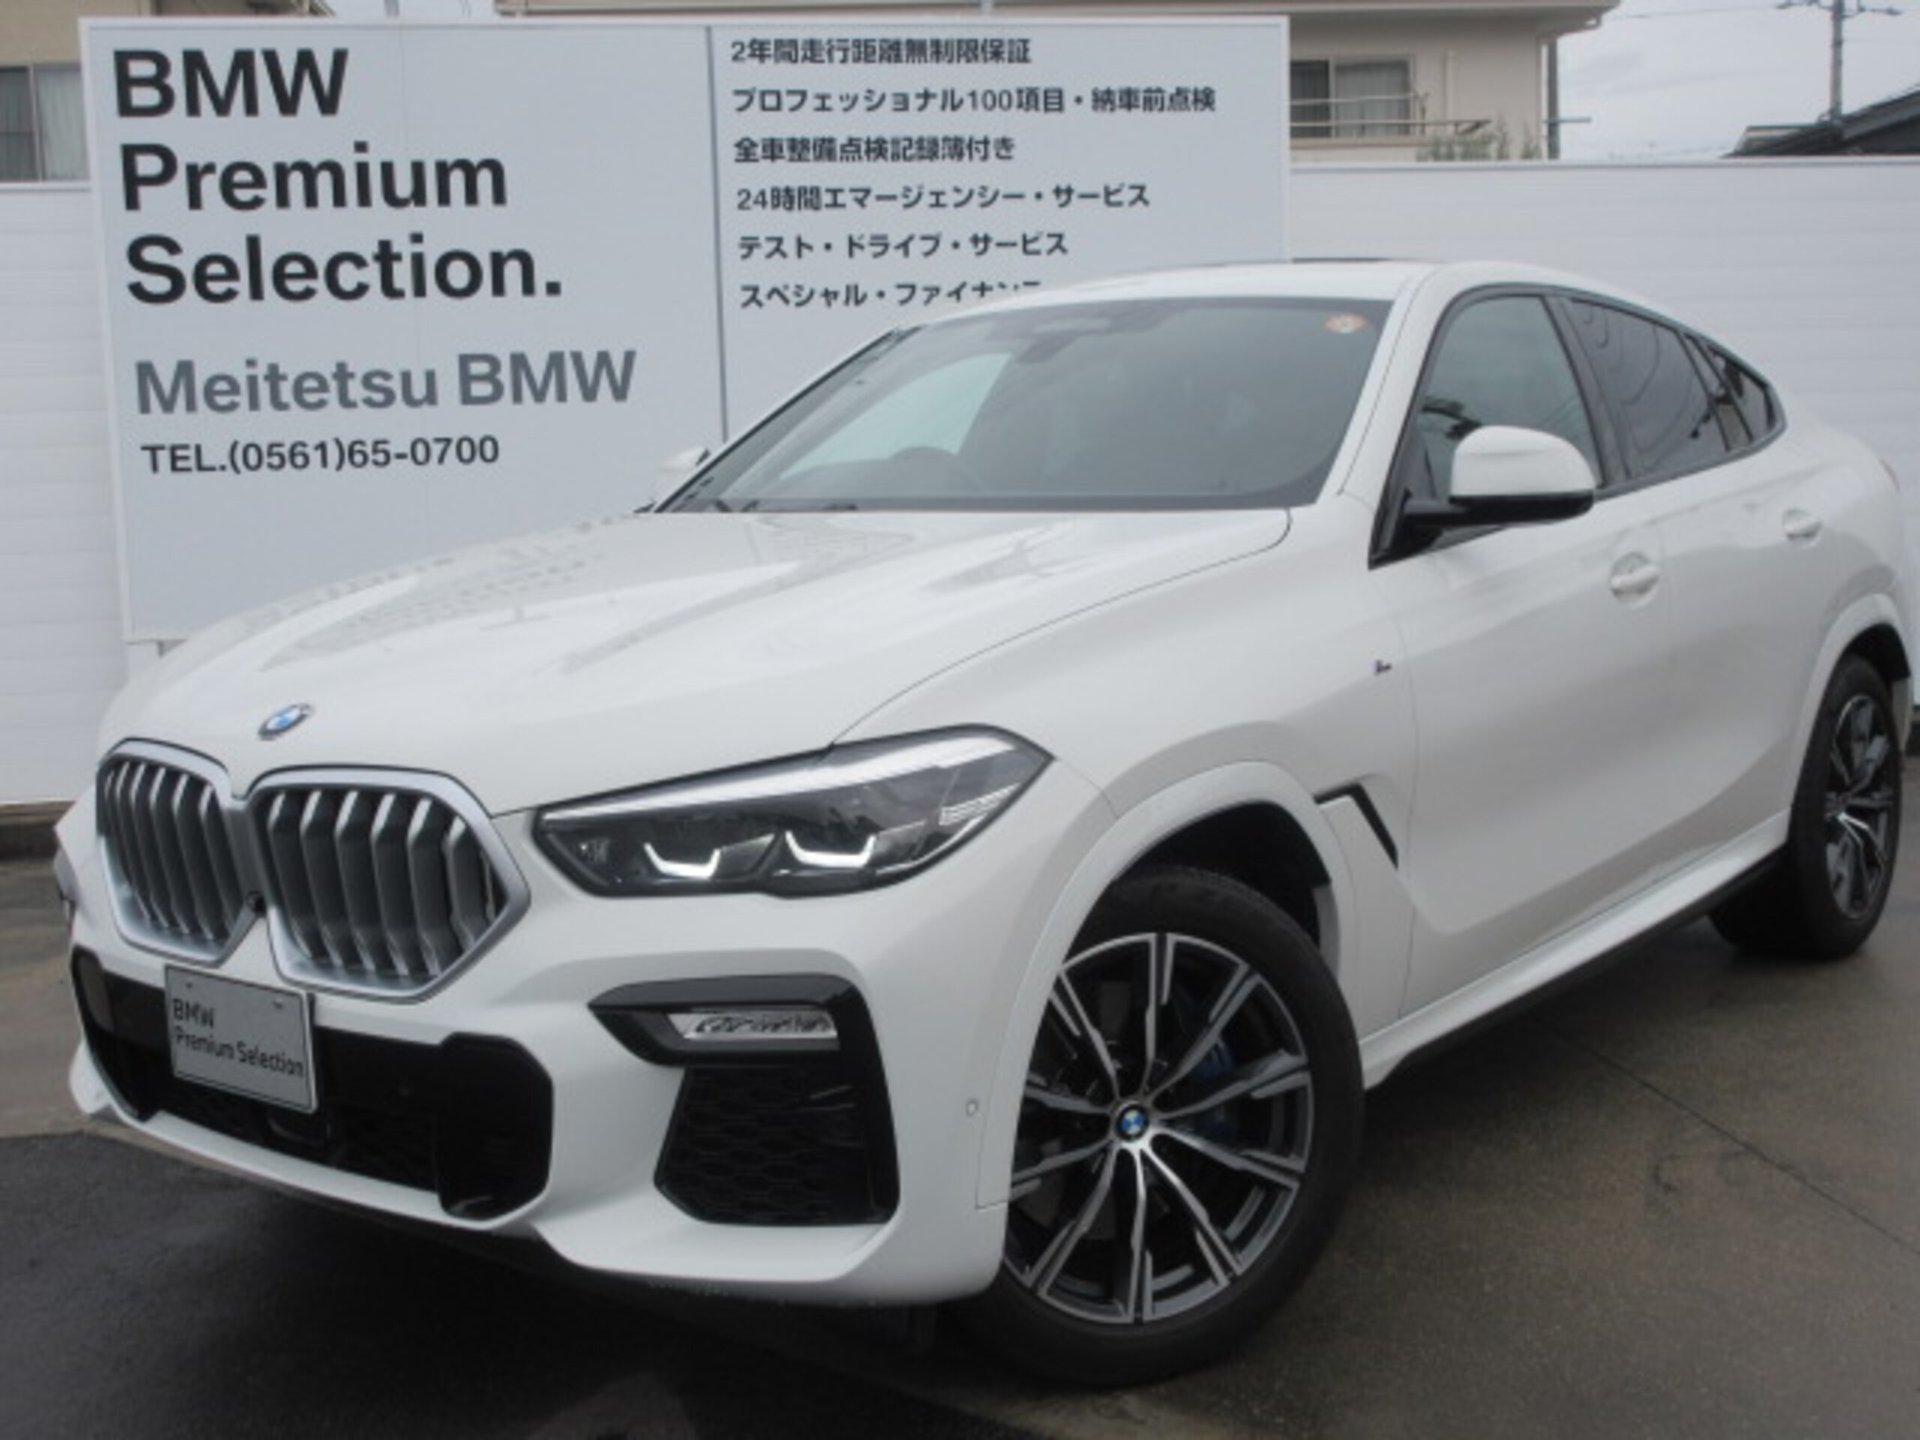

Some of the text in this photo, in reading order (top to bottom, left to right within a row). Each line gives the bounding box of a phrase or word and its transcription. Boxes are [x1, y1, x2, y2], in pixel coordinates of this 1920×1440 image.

[731, 37, 1032, 65] 2年間走行距離無制限保証
[113, 48, 349, 118] BMW
[732, 86, 1217, 114] プロフェッショナル100項目・納車前点検
[733, 135, 1015, 164] 全車整備点検記録簿付き
[120, 140, 507, 212] Premium
[737, 183, 1151, 213] 24時間エマージェンシー・サービス
[738, 232, 1069, 261] テスト・ドライブ・サービス
[126, 232, 562, 305] Selection.
[135, 349, 637, 415] Meitetsu BMW
[140, 434, 500, 475] TEL.(0561)65-0700
[173, 998, 215, 1028] BMW
[175, 1026, 304, 1077] Premium Selection
